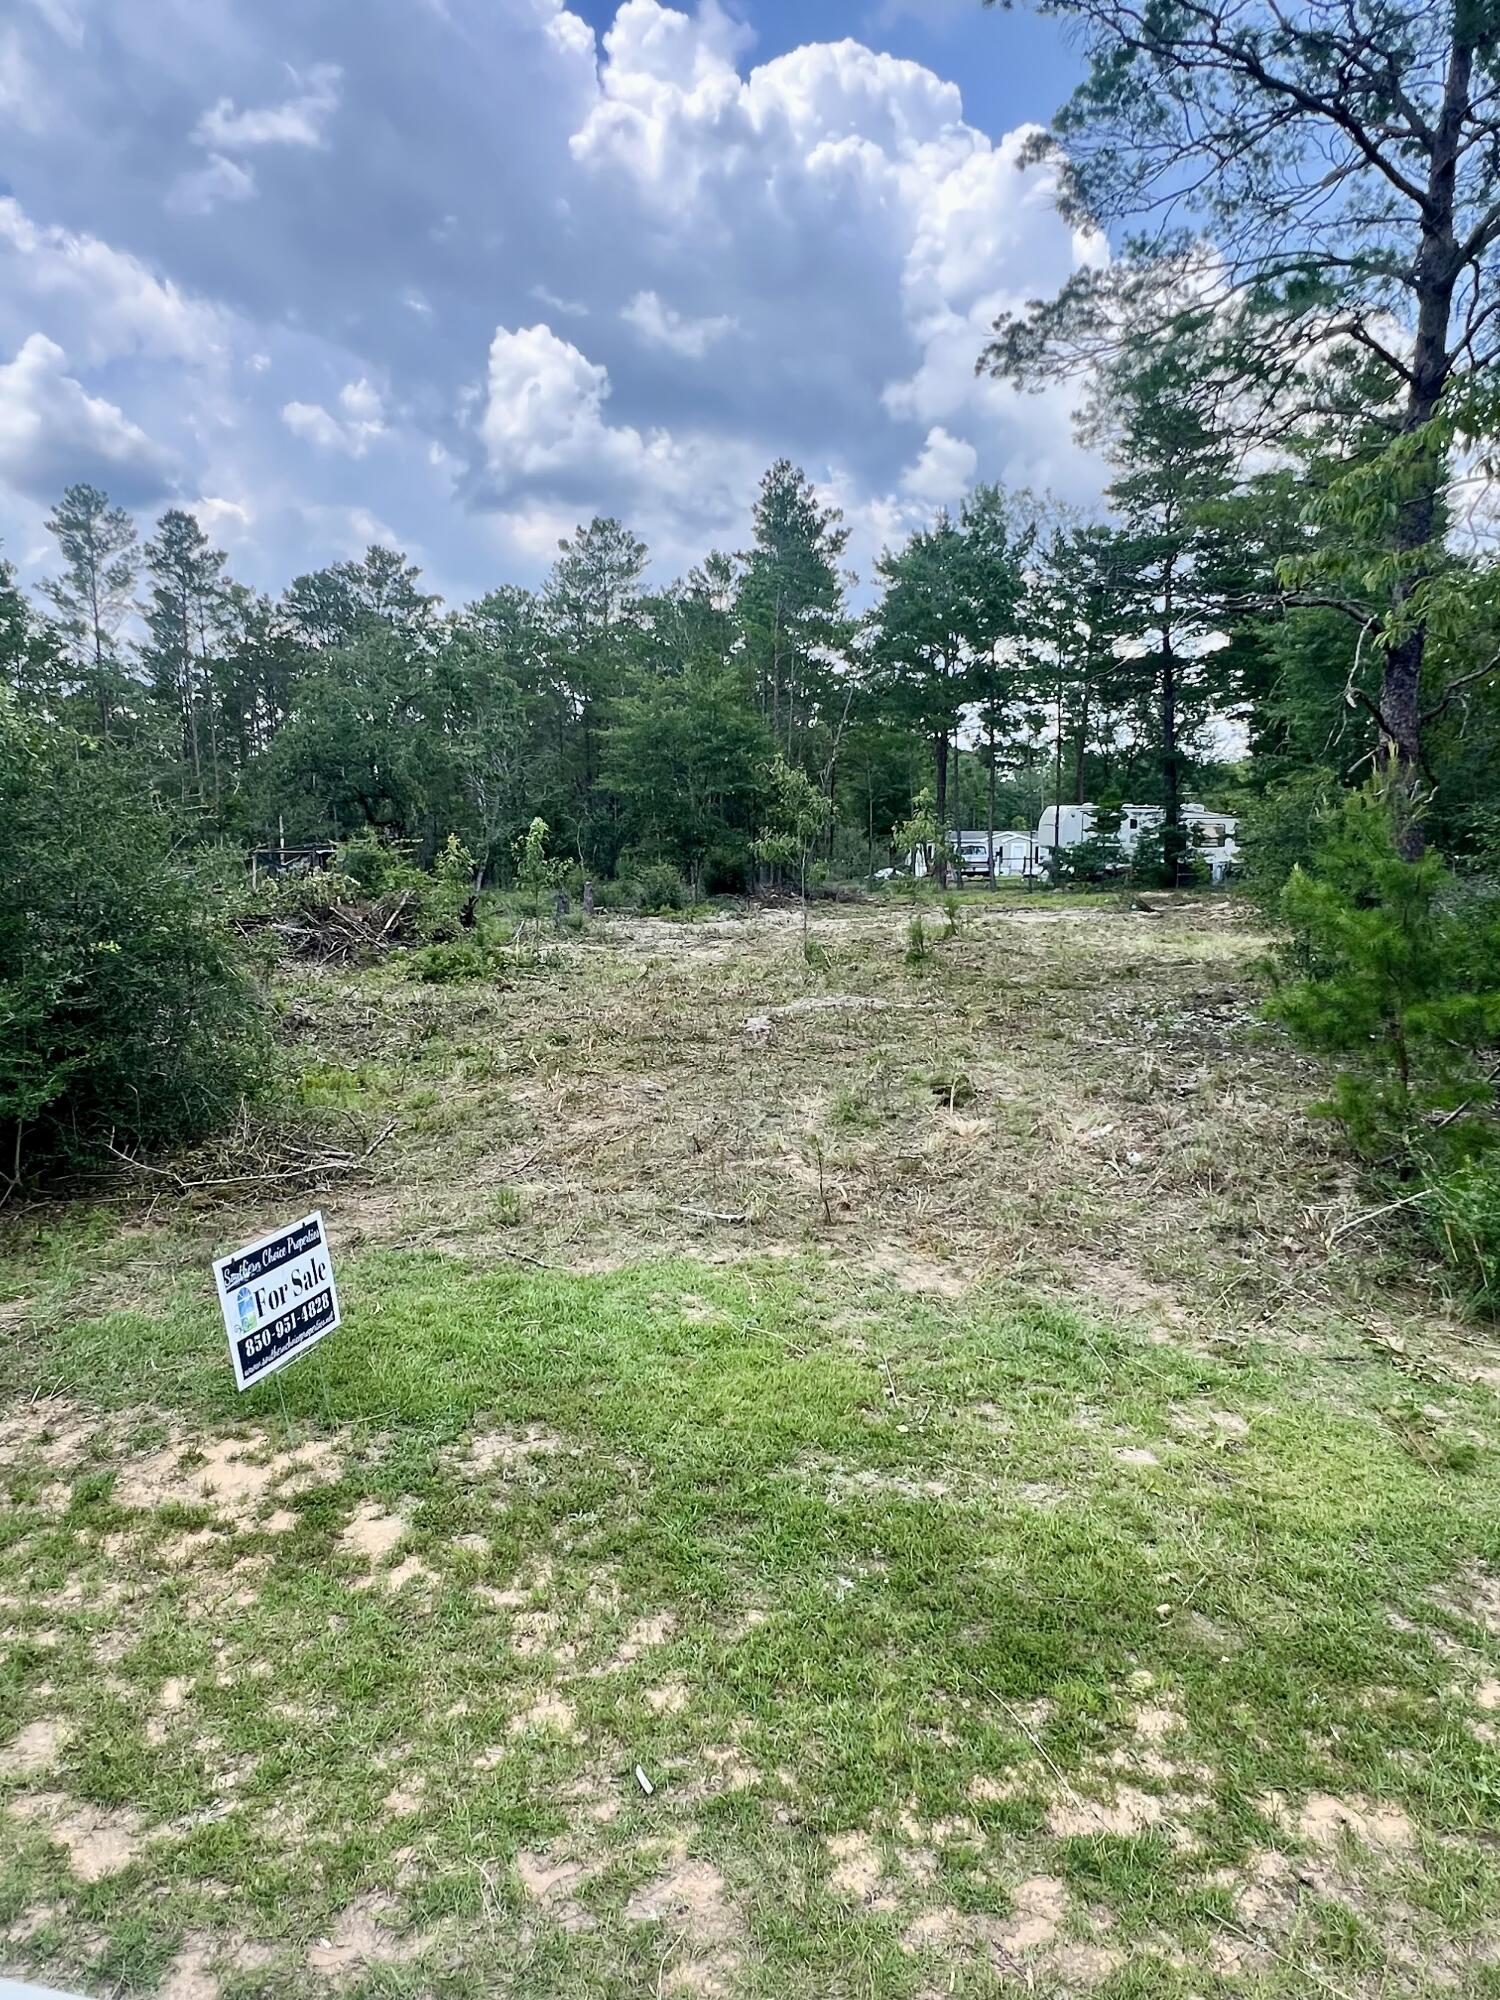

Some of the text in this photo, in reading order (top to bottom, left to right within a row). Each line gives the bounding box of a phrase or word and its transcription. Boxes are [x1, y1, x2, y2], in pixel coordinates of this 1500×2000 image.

[224, 1229, 320, 1287] Southern Choice Properties
[254, 1258, 326, 1318] For Sale
[245, 1292, 330, 1357] 850-951-4828
